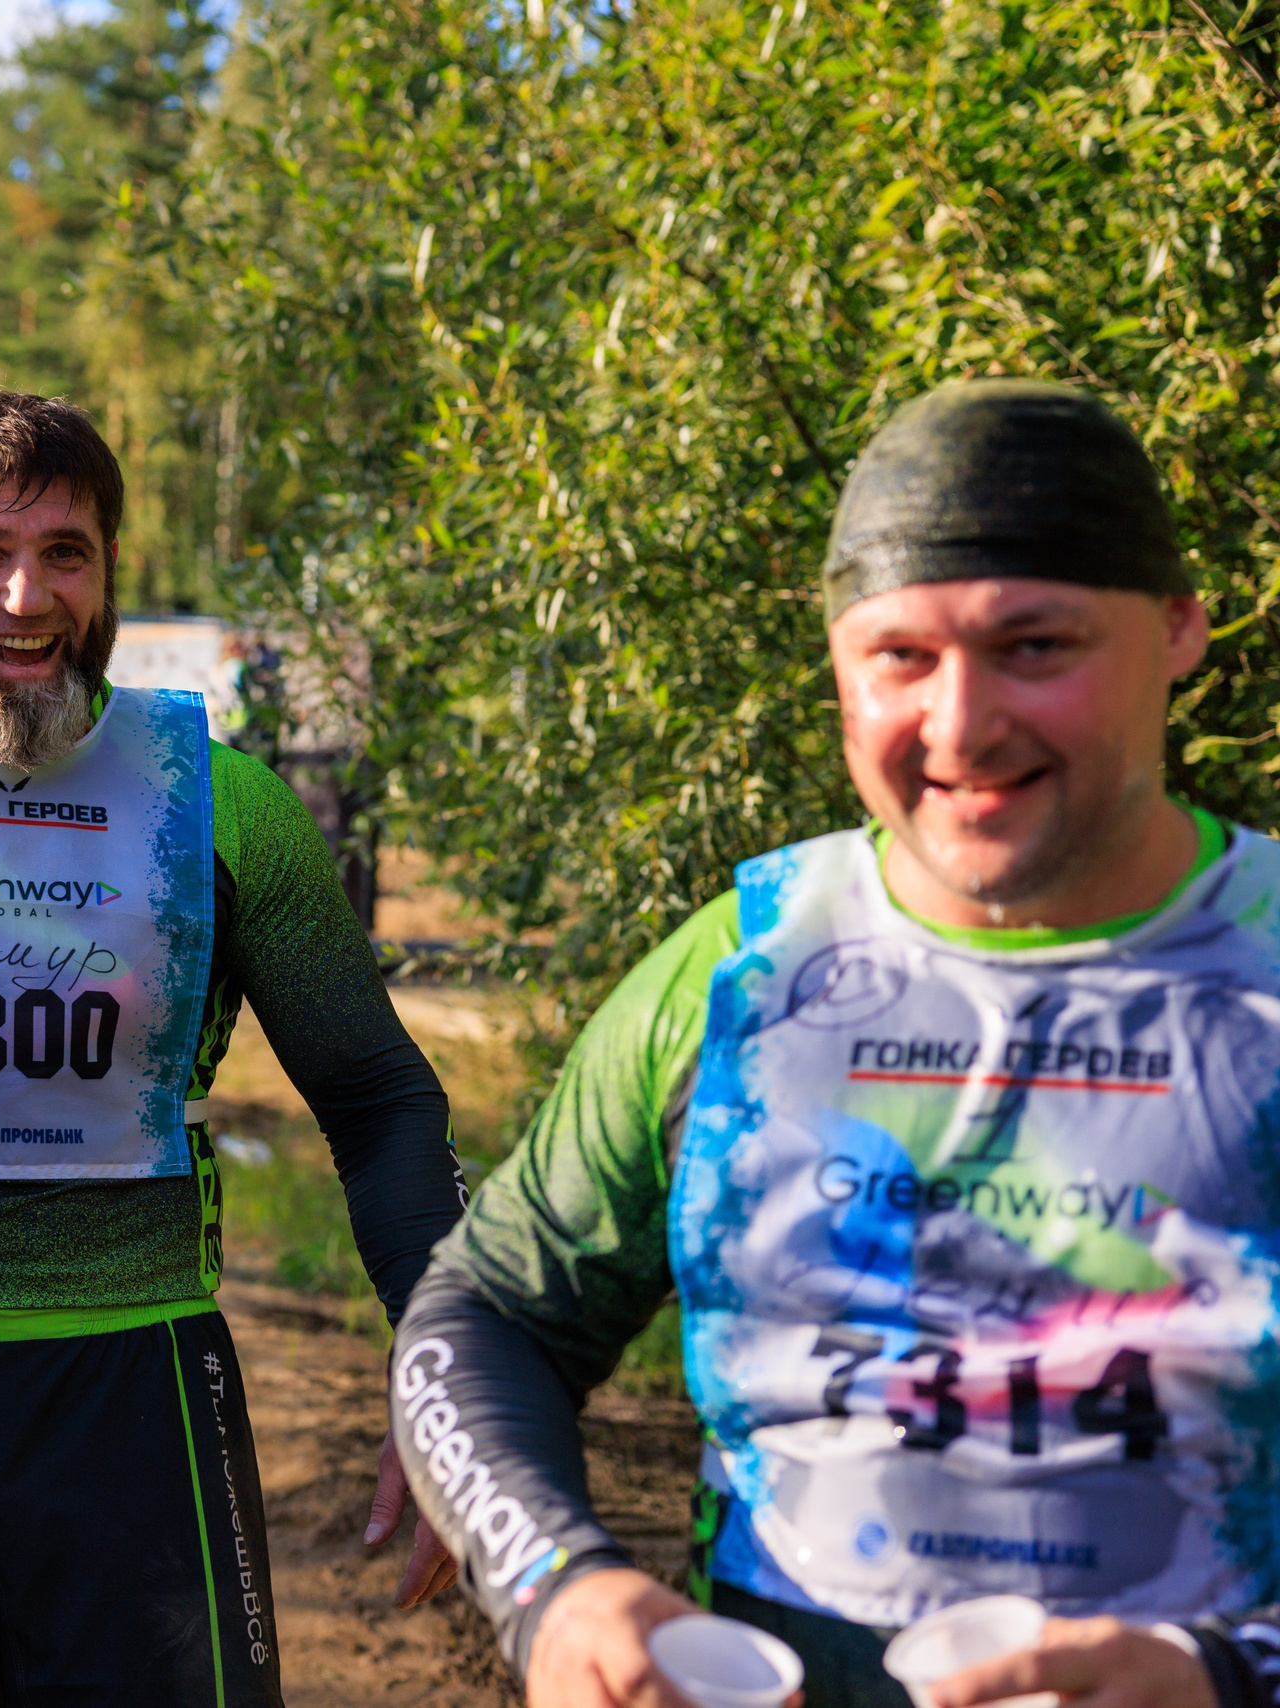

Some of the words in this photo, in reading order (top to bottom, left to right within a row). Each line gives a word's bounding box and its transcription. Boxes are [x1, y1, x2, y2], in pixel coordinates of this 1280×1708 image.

[8, 800, 109, 824] ГЕРОЕВ
[1004, 1040, 1172, 1080] ГЕРОЕВ
[814, 1153, 1131, 1230] Greenway
[811, 1328, 1169, 1460] 7314
[396, 1336, 555, 1589] Greenway
